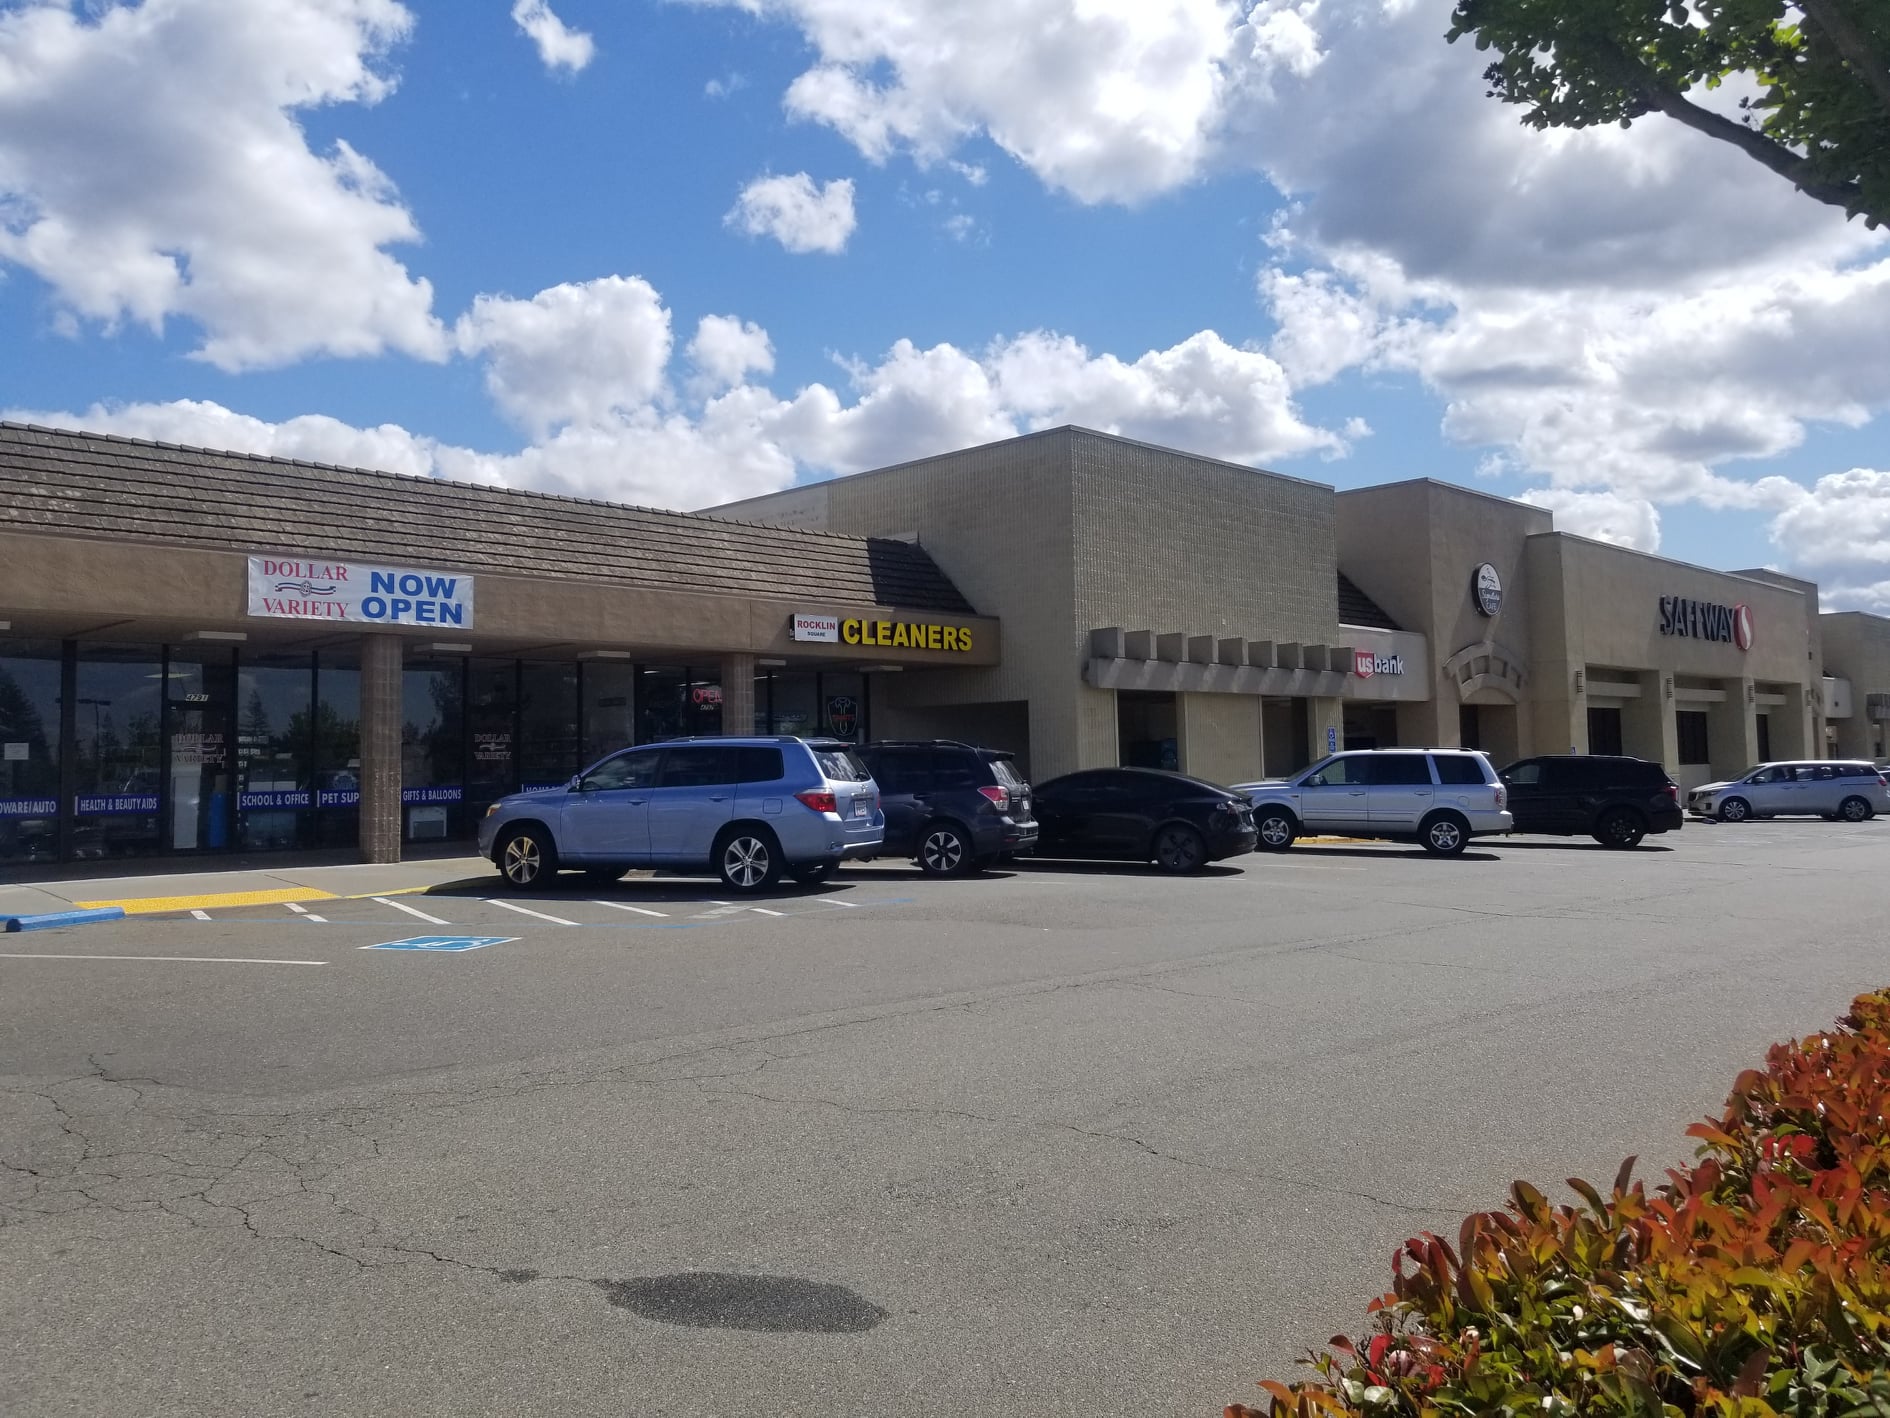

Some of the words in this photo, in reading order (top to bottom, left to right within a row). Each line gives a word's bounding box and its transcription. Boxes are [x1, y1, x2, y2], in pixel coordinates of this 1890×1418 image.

[263, 560, 348, 581] DOLLAR
[370, 571, 457, 599] NOW
[262, 598, 349, 617] VARIETY
[361, 596, 463, 624] OPEN
[797, 620, 836, 631] ROCKLIN
[1659, 594, 1735, 643] SAFEWAY
[842, 618, 973, 651] CLEANERS
[692, 688, 722, 704] OPEN
[474, 733, 512, 743] DOLLAR
[474, 751, 512, 760] VARIETY
[242, 795, 274, 806] SCHOOL
[276, 794, 282, 805] &
[284, 793, 309, 805] OFFICE
[322, 793, 338, 804] PET
[403, 790, 420, 801] GIFTS
[421, 790, 427, 800] &
[428, 789, 462, 800] BALLOONS
[80, 799, 106, 811] HEALTH
[107, 799, 113, 810] &
[115, 798, 141, 810] BEAUTY
[142, 798, 157, 809] AIDS
